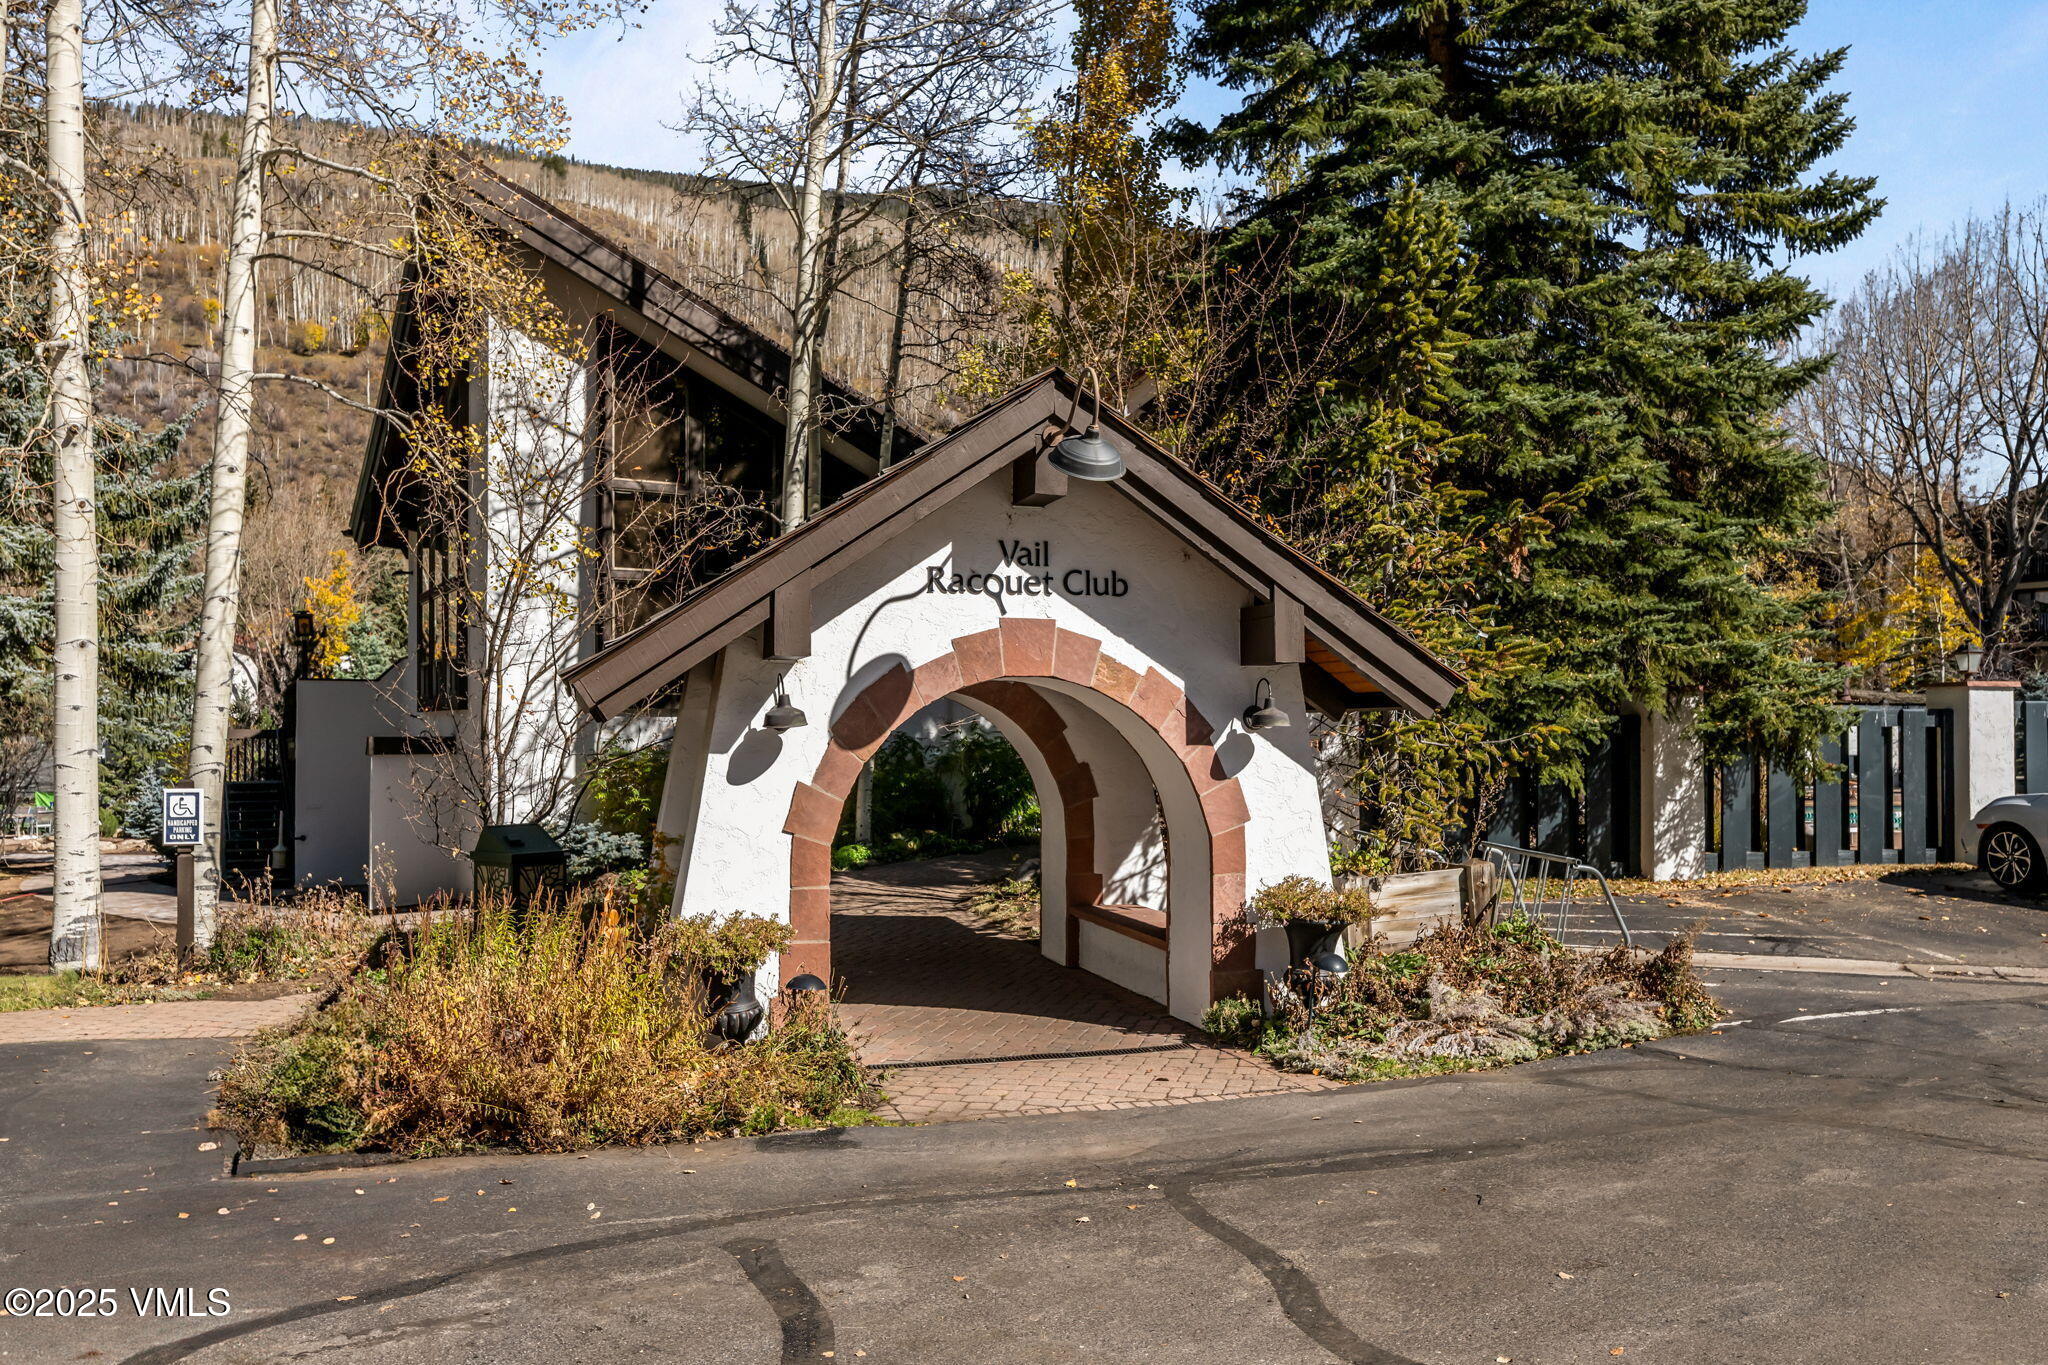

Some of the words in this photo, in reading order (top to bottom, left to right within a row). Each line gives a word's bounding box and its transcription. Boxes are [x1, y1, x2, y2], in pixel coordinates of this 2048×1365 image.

[998, 540, 1049, 568] Vail
[1063, 569, 1129, 597] Club
[167, 819, 198, 827] HANDICAPPED
